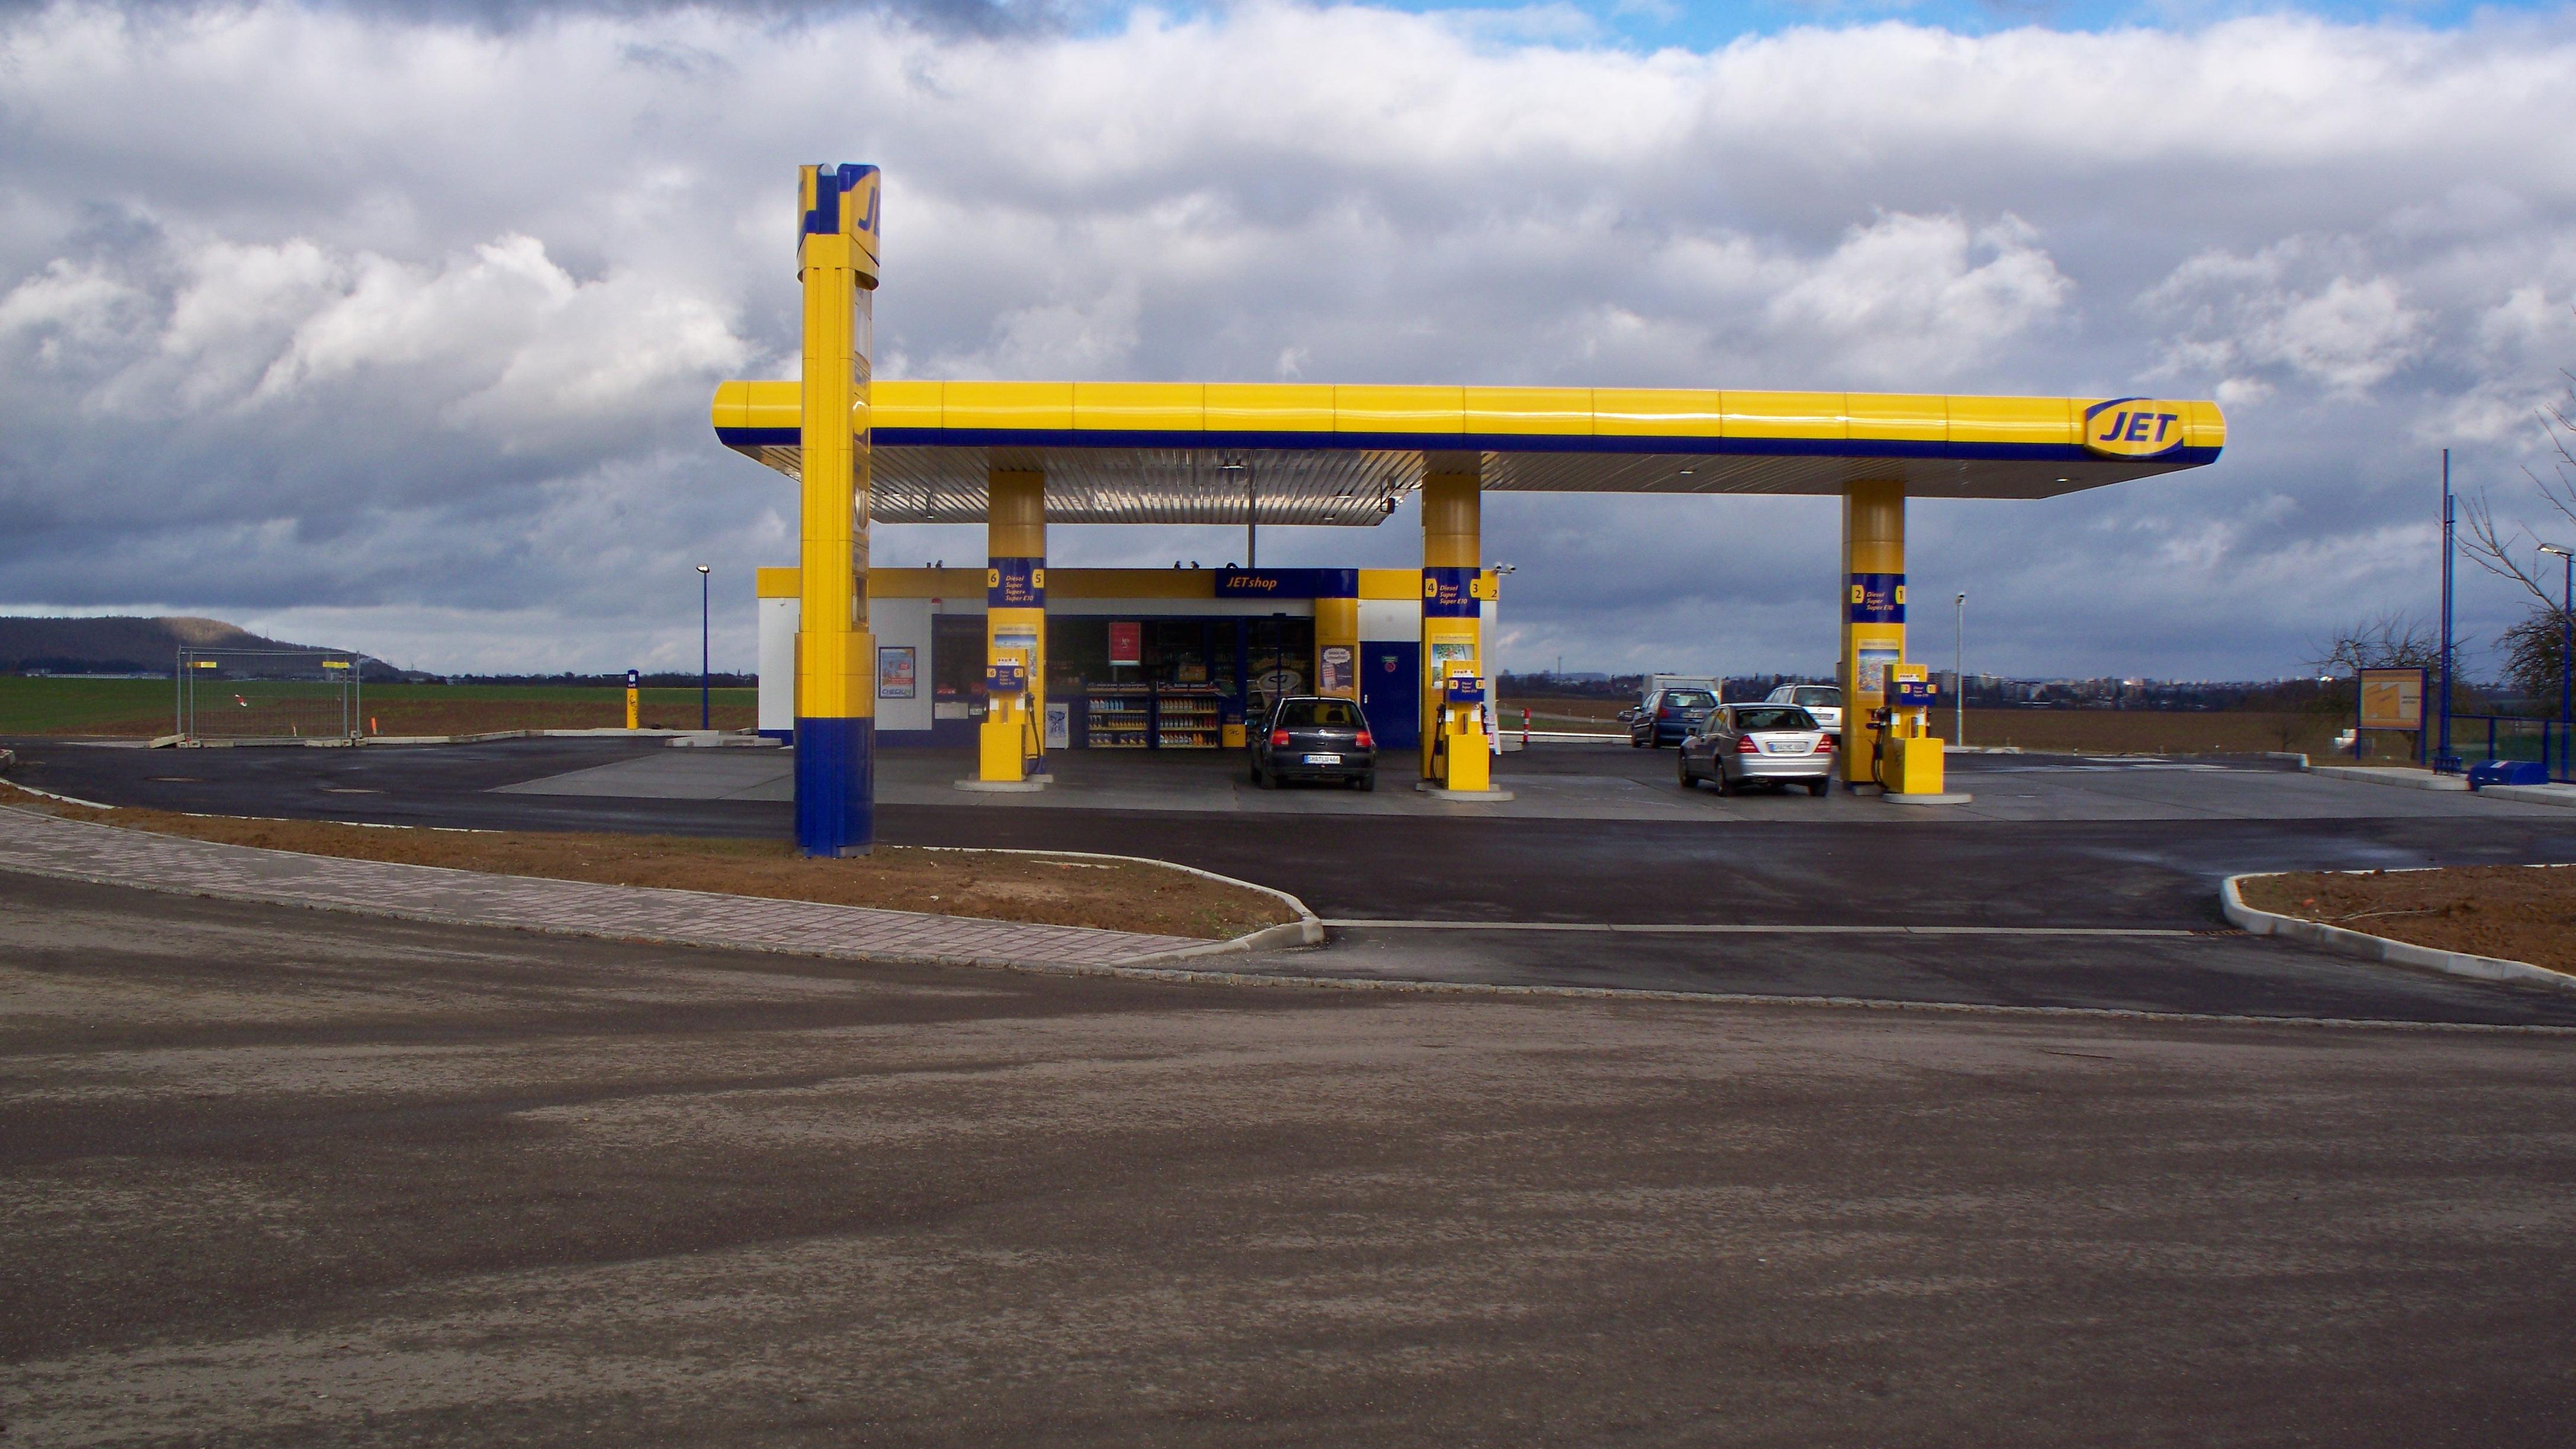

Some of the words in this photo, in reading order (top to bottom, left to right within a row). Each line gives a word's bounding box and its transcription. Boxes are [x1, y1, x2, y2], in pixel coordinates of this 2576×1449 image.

[2100, 412, 2178, 442] JET
[991, 574, 996, 582] 6
[1035, 574, 1041, 582] 5
[1428, 583, 1434, 592] 4
[1473, 584, 1478, 593] 3
[1856, 590, 1861, 598] 2
[1899, 591, 1902, 599] 1
